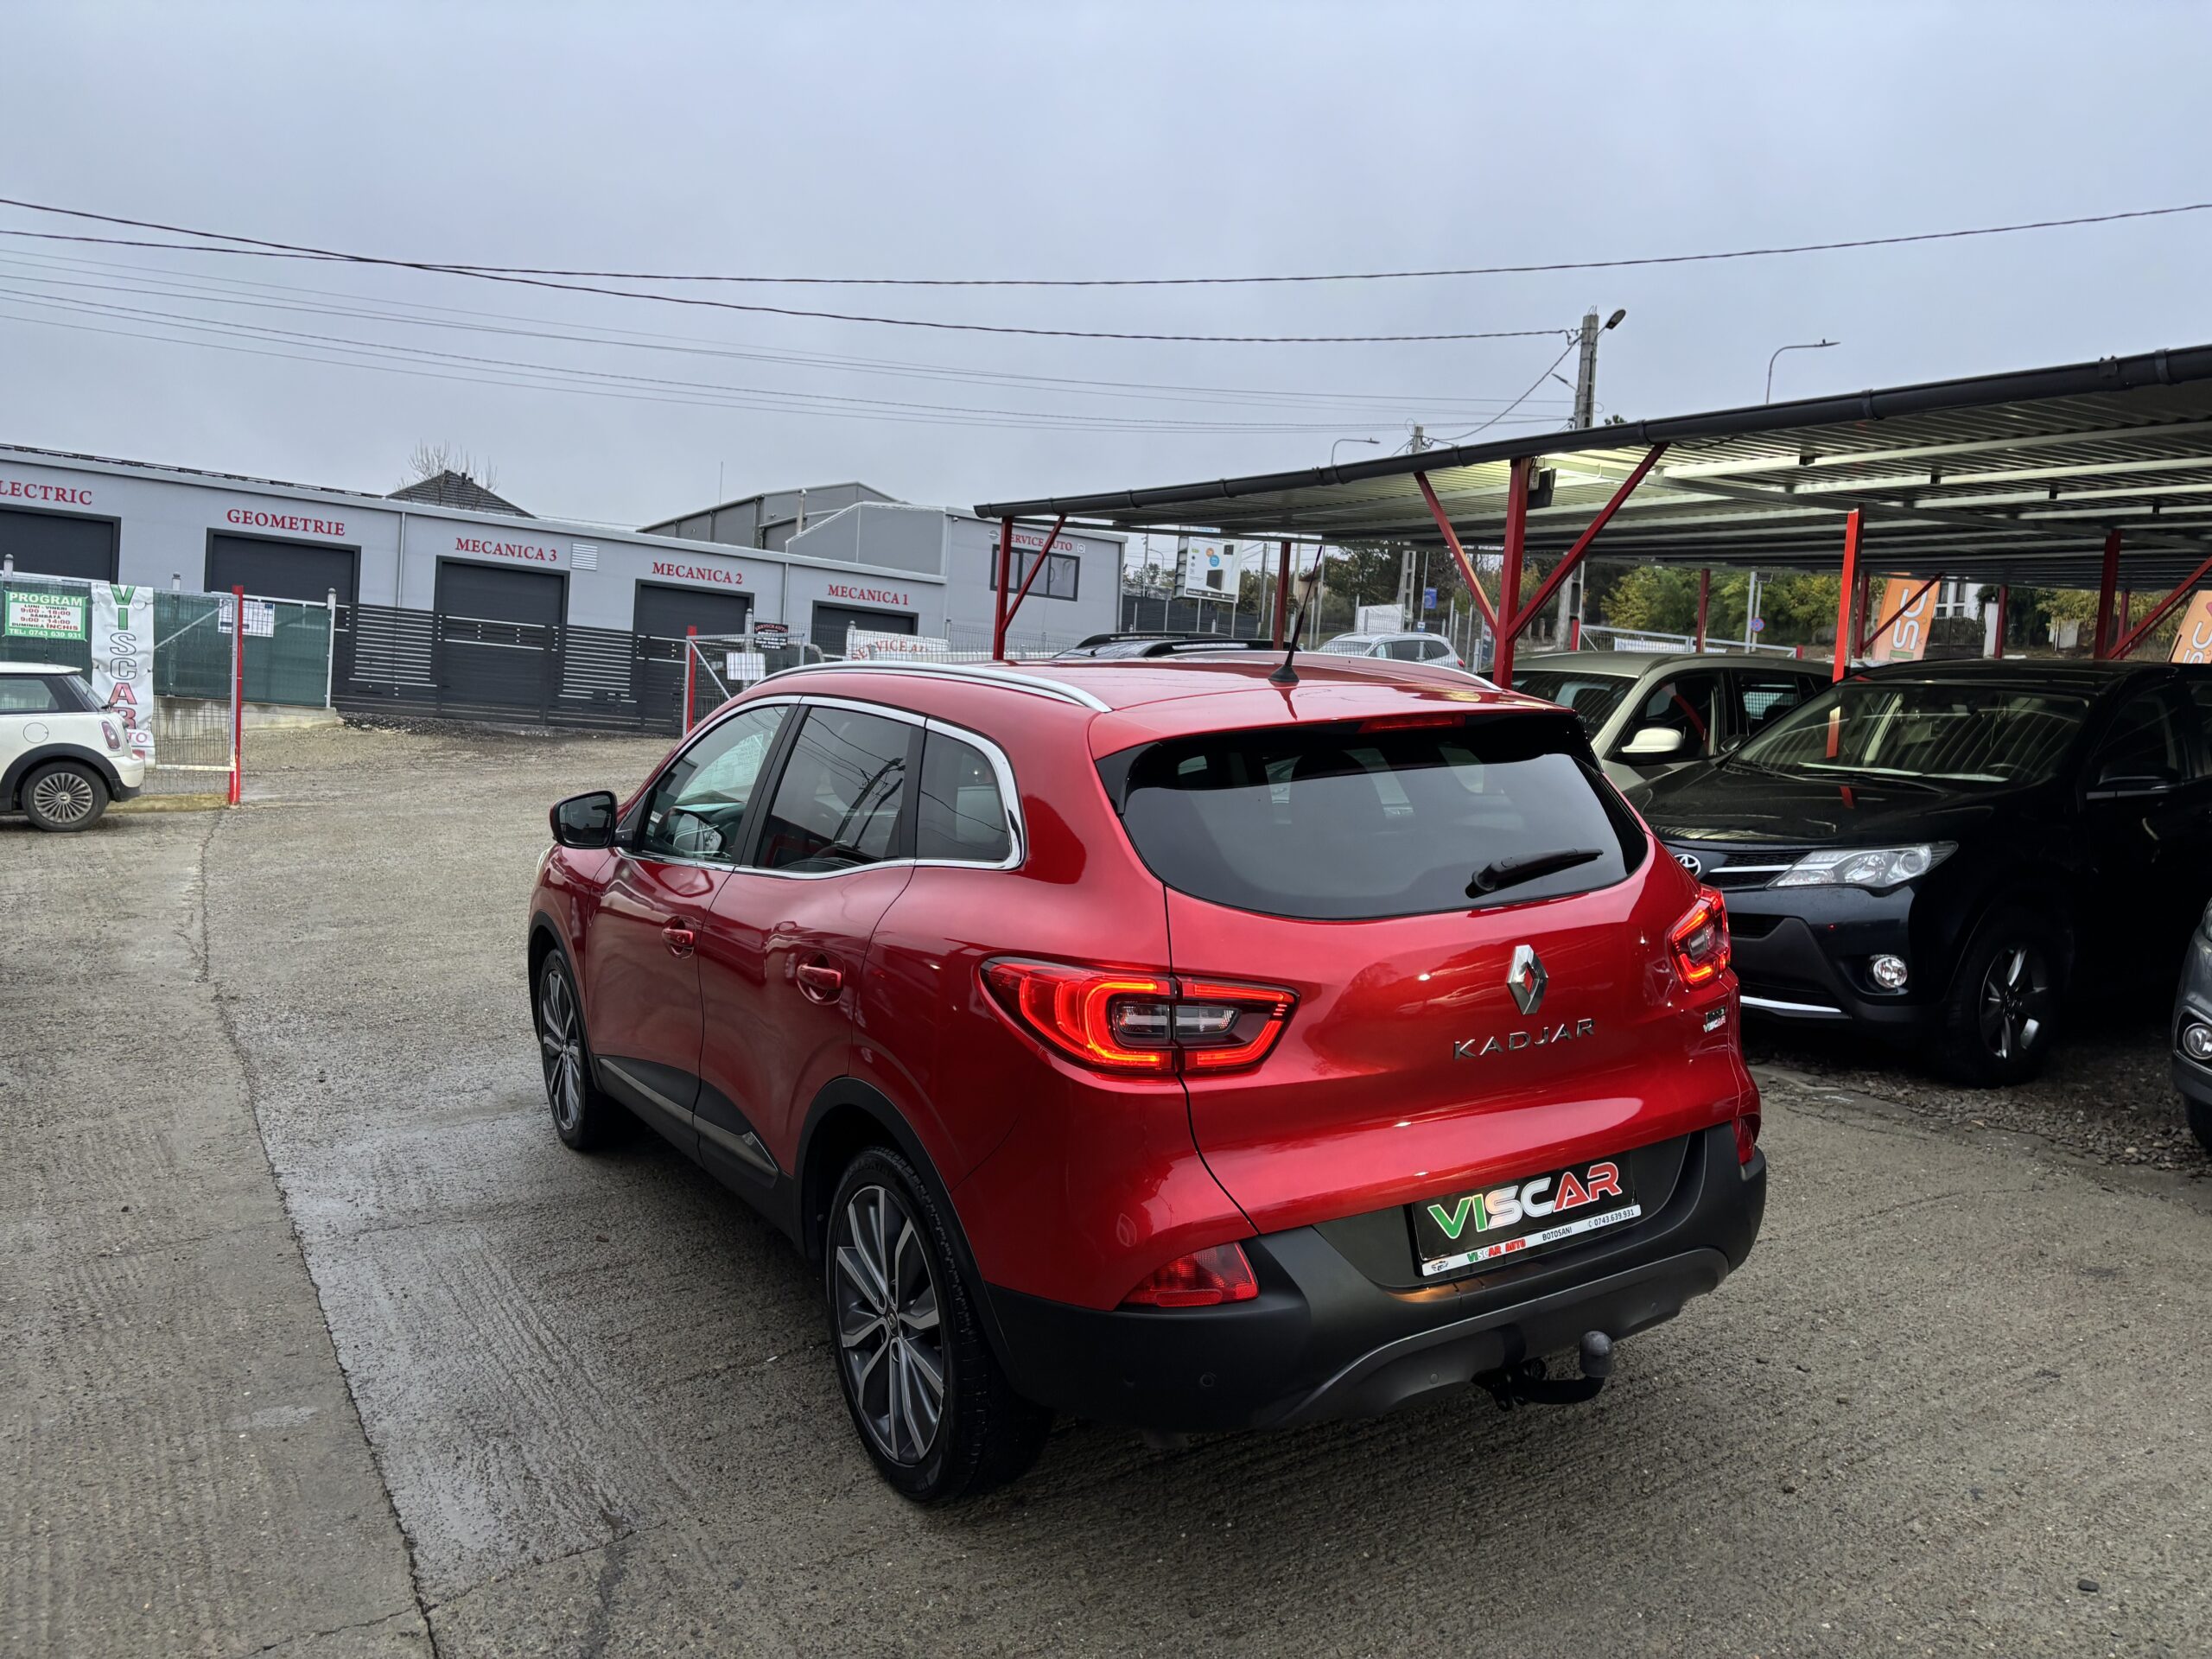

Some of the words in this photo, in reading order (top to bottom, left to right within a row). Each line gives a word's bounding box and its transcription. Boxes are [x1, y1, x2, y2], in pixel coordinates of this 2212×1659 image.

[0, 480, 92, 505] LECTRIC
[226, 509, 346, 537] GEOMETRIE
[455, 537, 545, 561] MECANICA
[549, 549, 557, 562] 3
[1011, 533, 1044, 547] ERVICE
[1052, 540, 1073, 551] UTO
[652, 562, 733, 584] MECANICA
[735, 573, 743, 585] 2
[9, 592, 83, 607] PROGRAM
[828, 584, 900, 605] MECANICA
[903, 594, 909, 606] 1
[1453, 1018, 1596, 1060] KADJAR
[1427, 1161, 1623, 1239] VISCAR
[1466, 1245, 1502, 1262] VISCAR
[1505, 1238, 1527, 1253] AUTO
[1541, 1227, 1573, 1242] BOTOSANI
[1593, 1208, 1635, 1226] 0743.639.931
